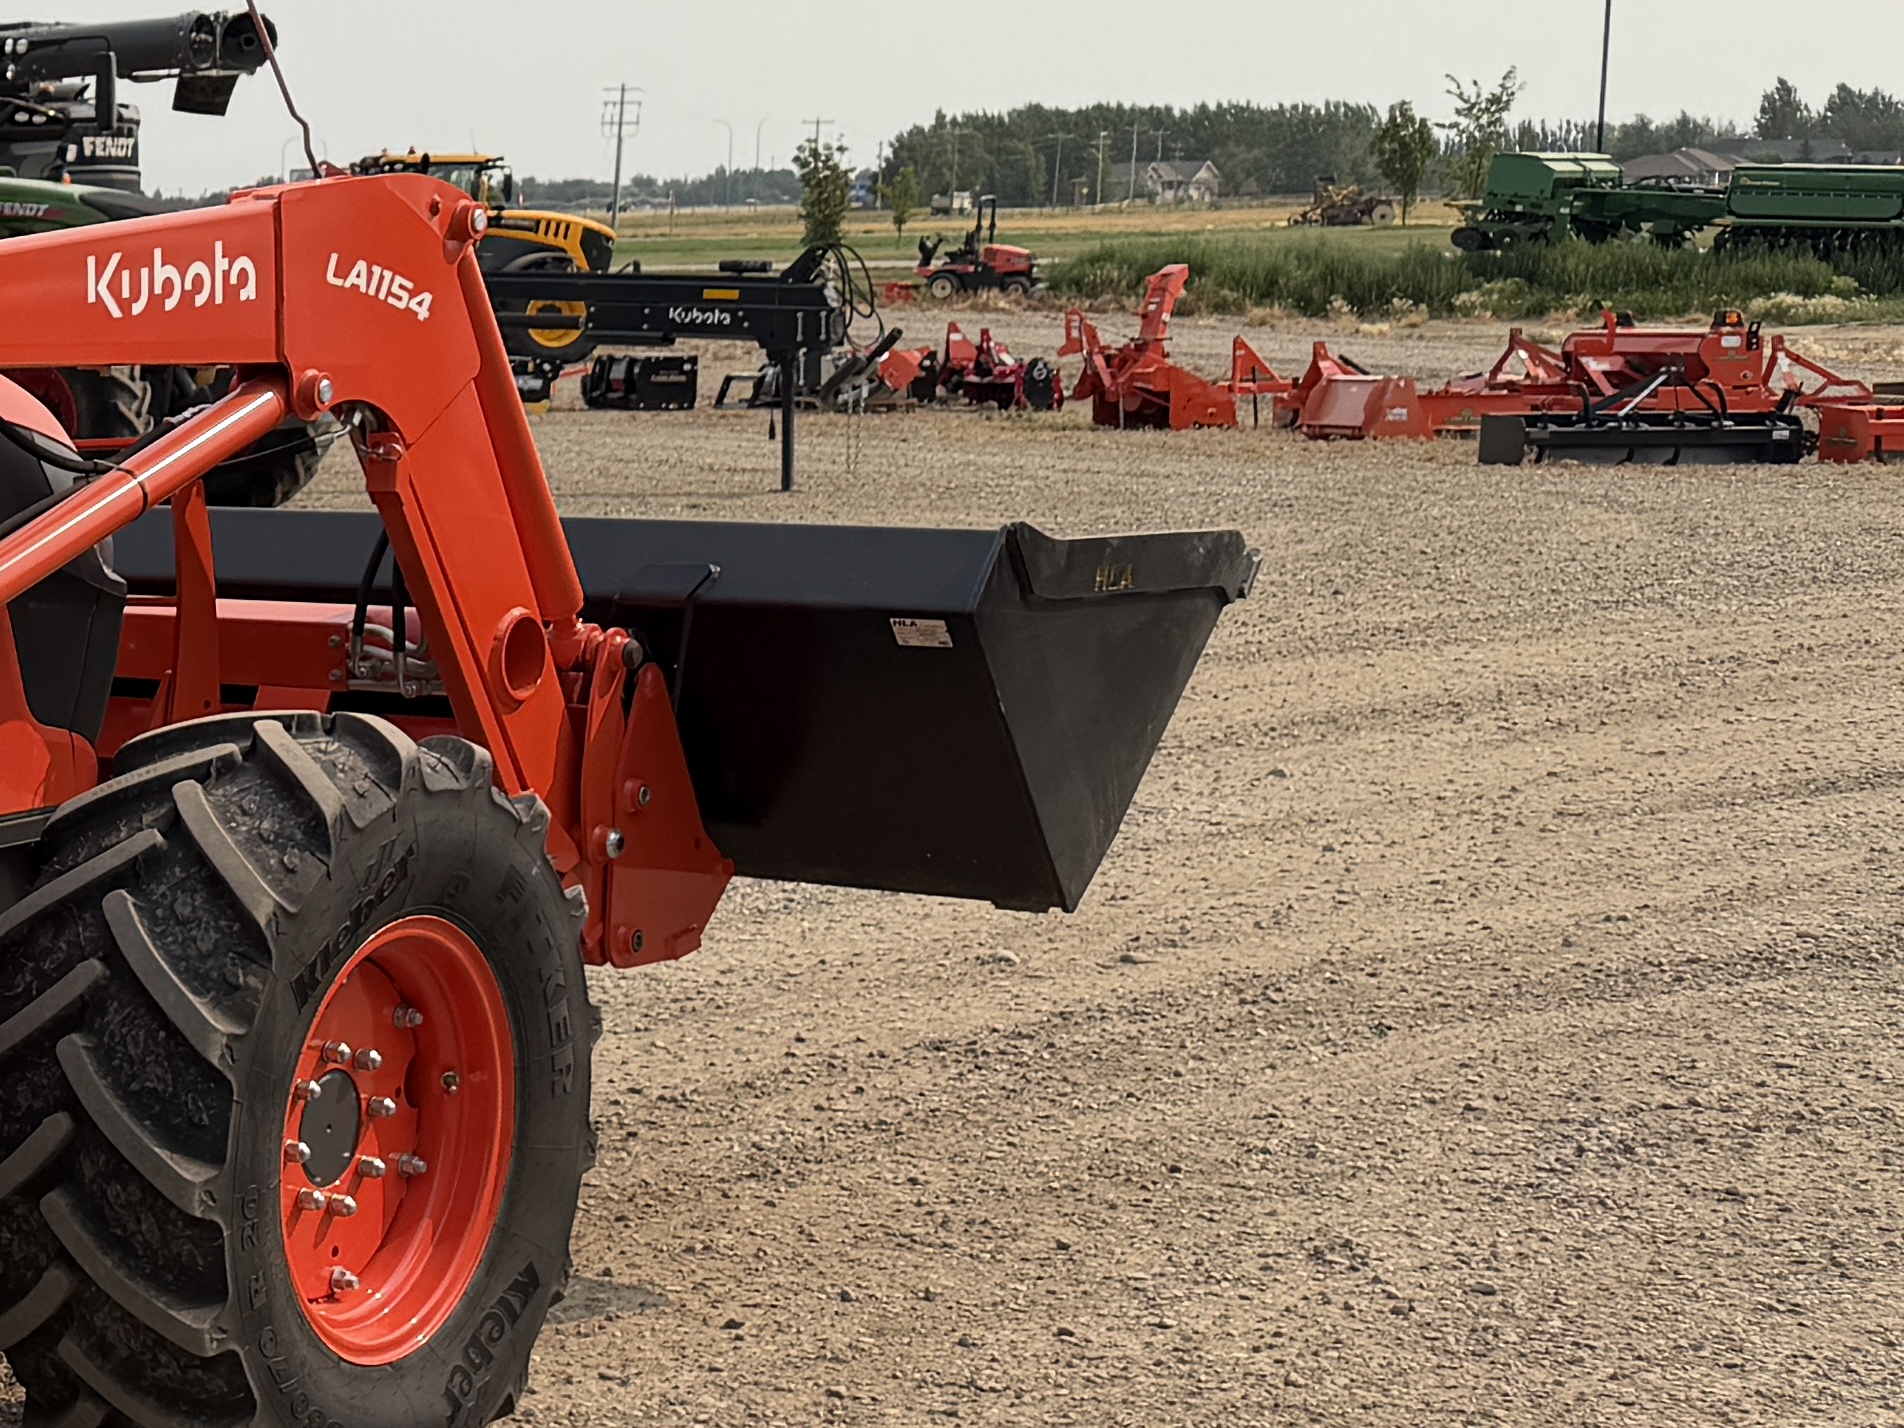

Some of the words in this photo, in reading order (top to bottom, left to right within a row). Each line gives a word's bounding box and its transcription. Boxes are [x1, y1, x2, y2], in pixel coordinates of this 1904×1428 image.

[82, 135, 136, 158] FENDT
[86, 240, 257, 319] Kubota
[326, 252, 434, 322] LA1154
[668, 306, 732, 325] Kubota
[1093, 563, 1135, 592] HLA
[892, 619, 918, 628] HLA
[288, 840, 417, 1016] Kleber
